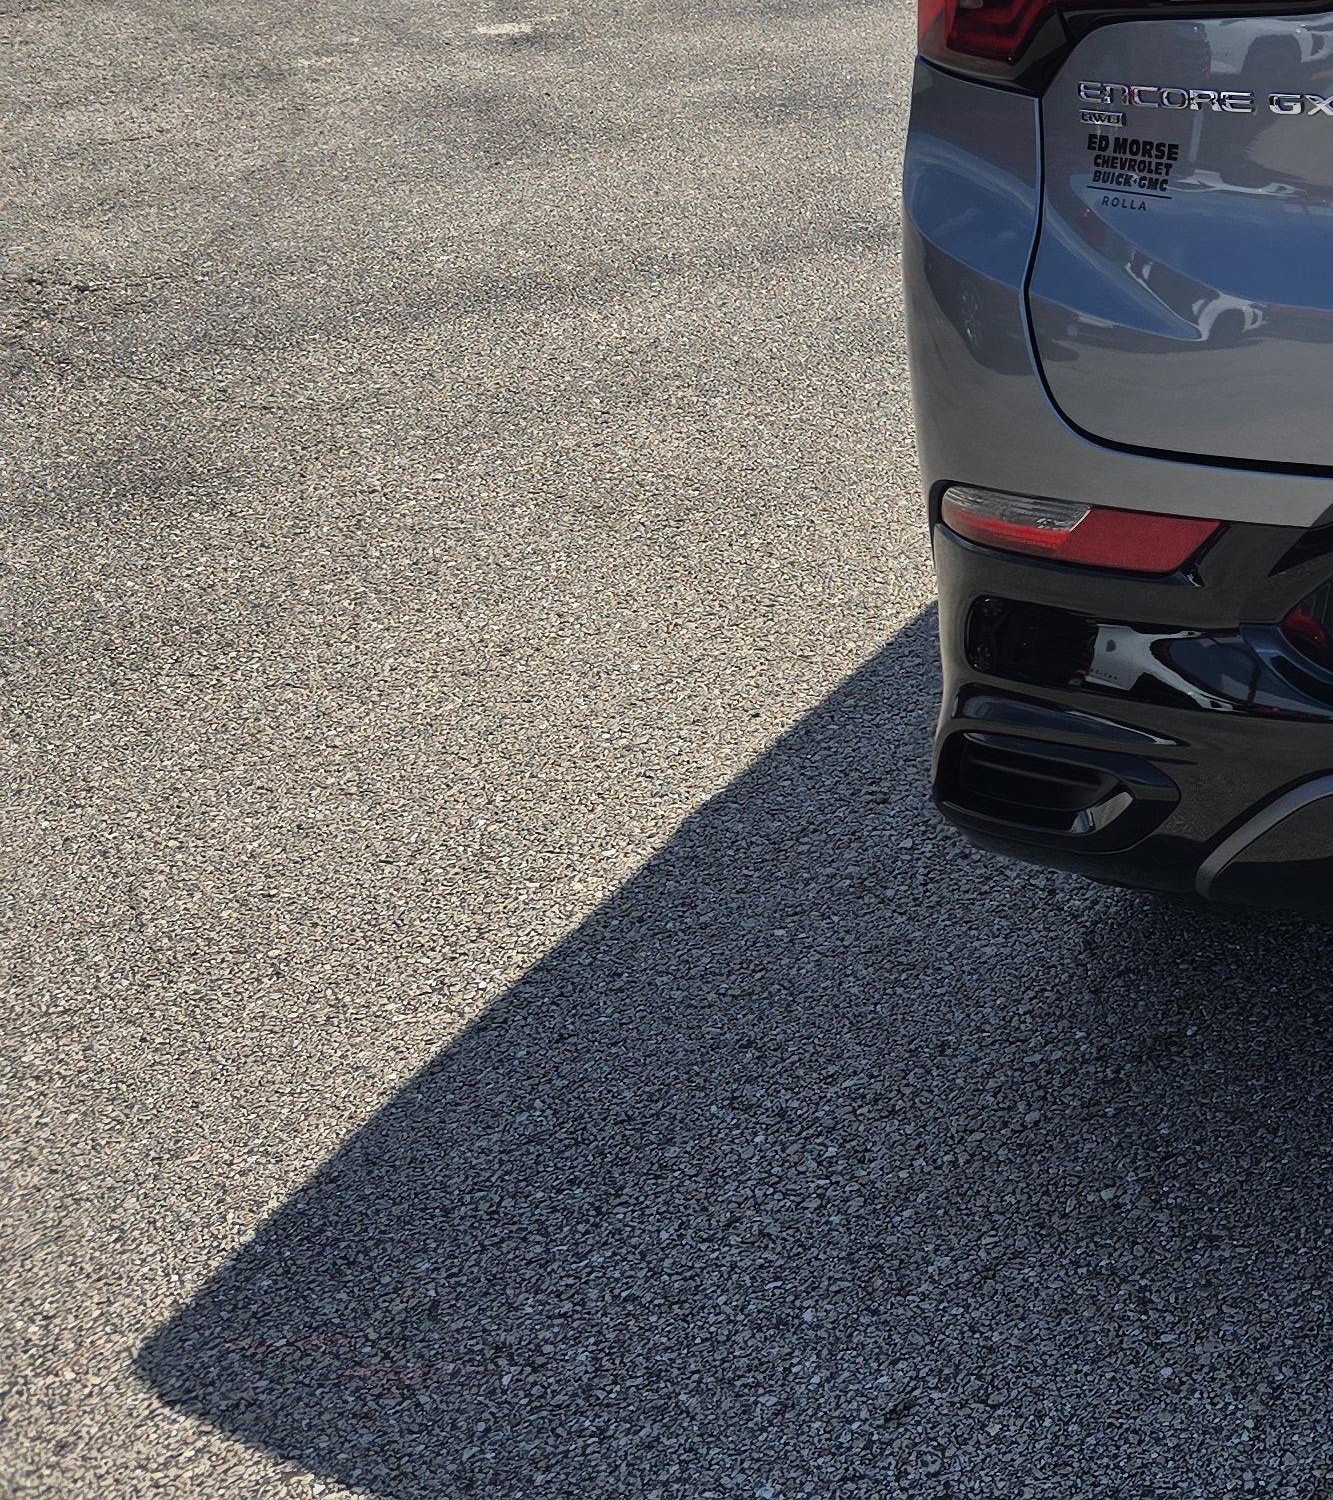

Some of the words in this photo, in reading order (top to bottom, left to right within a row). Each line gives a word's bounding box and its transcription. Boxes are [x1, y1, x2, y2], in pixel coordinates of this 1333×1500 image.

[1077, 81, 1255, 113] ENCORE
[1087, 133, 1110, 153] ED
[1113, 136, 1180, 162] MORSE
[1093, 153, 1173, 177] CHEVROLET
[1101, 195, 1147, 211] ROLLA
